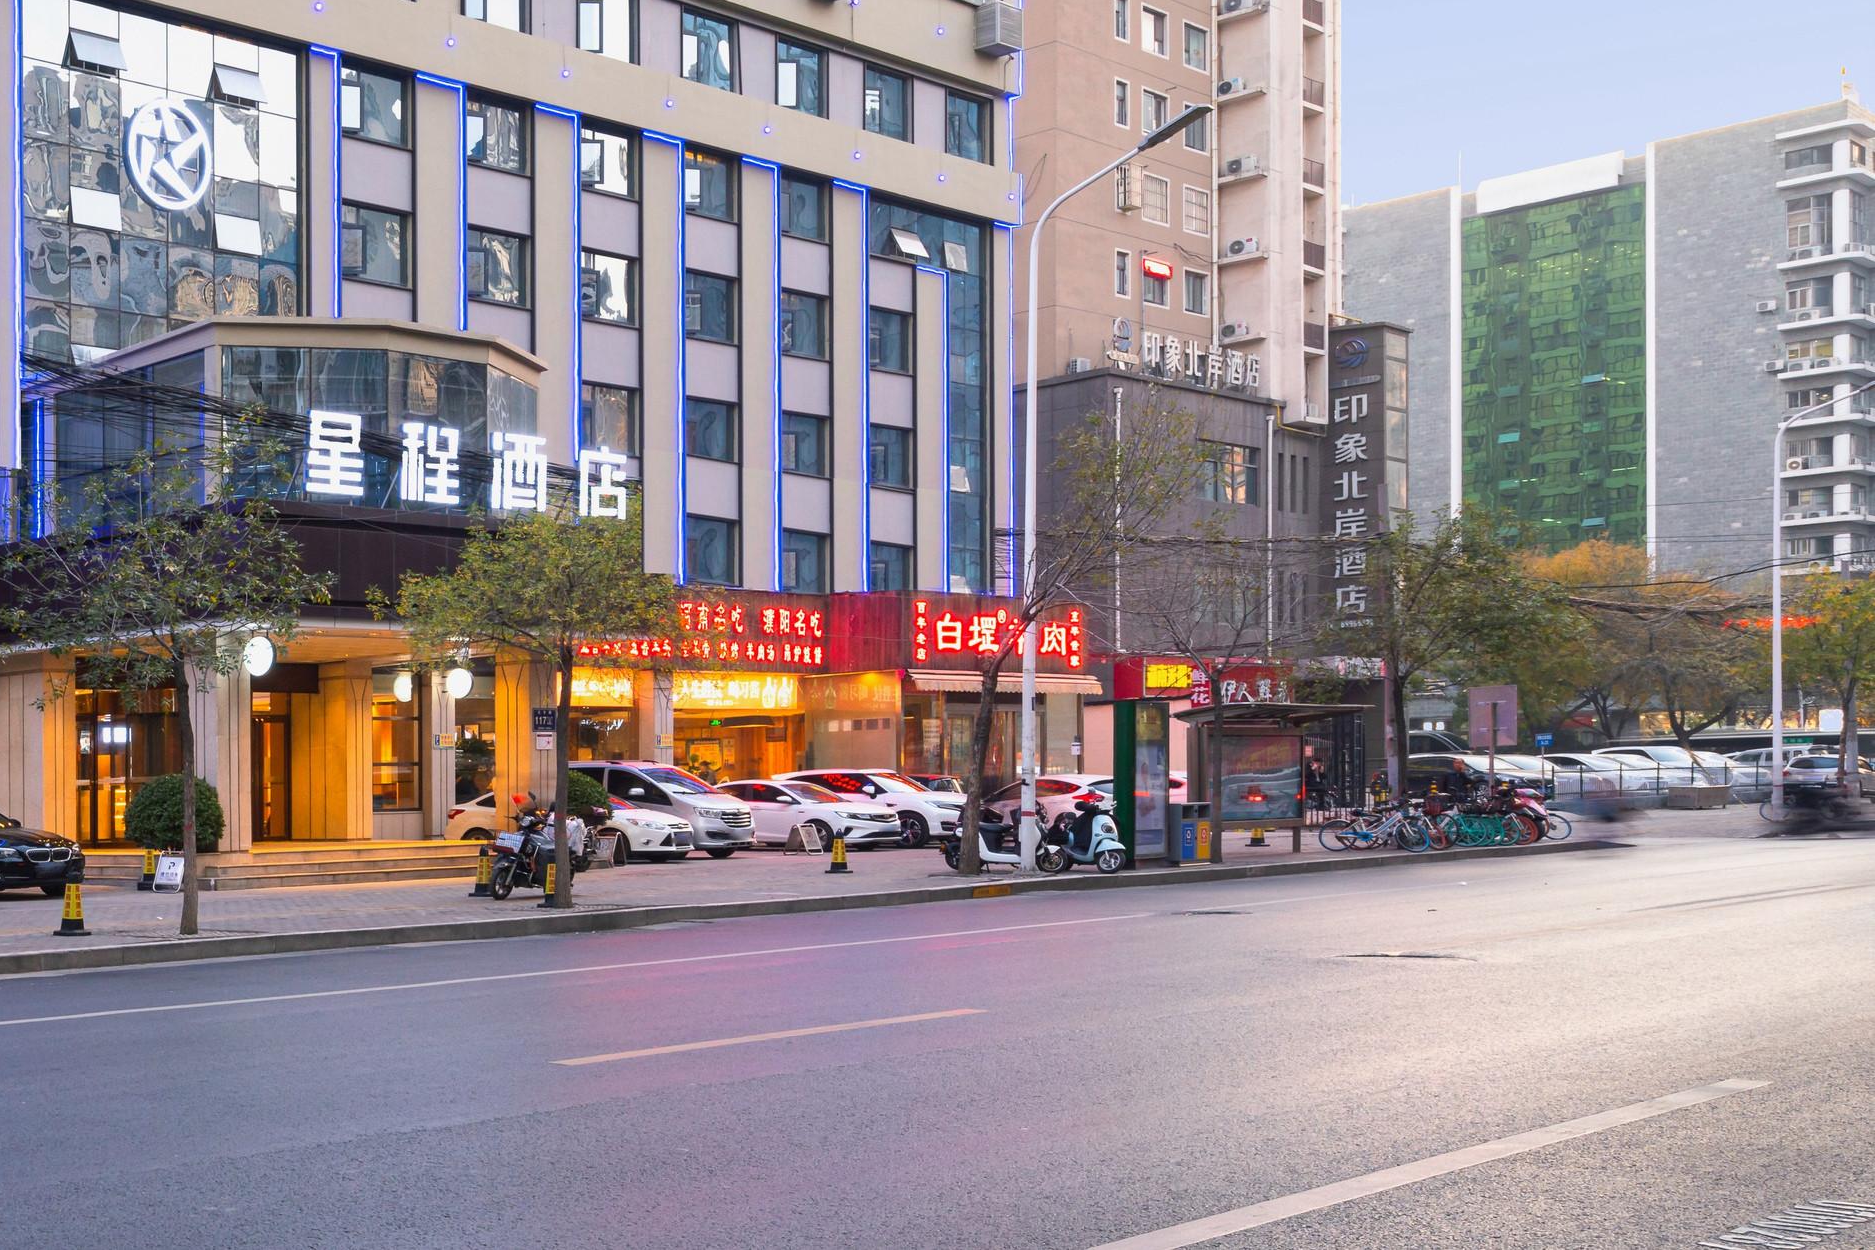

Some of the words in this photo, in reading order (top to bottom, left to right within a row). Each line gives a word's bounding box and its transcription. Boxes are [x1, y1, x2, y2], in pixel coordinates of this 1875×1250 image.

[1143, 331, 1261, 390] 印象北岸酒店
[305, 409, 627, 520] 星程酒店
[1333, 393, 1368, 614] 印象北岸酒店
